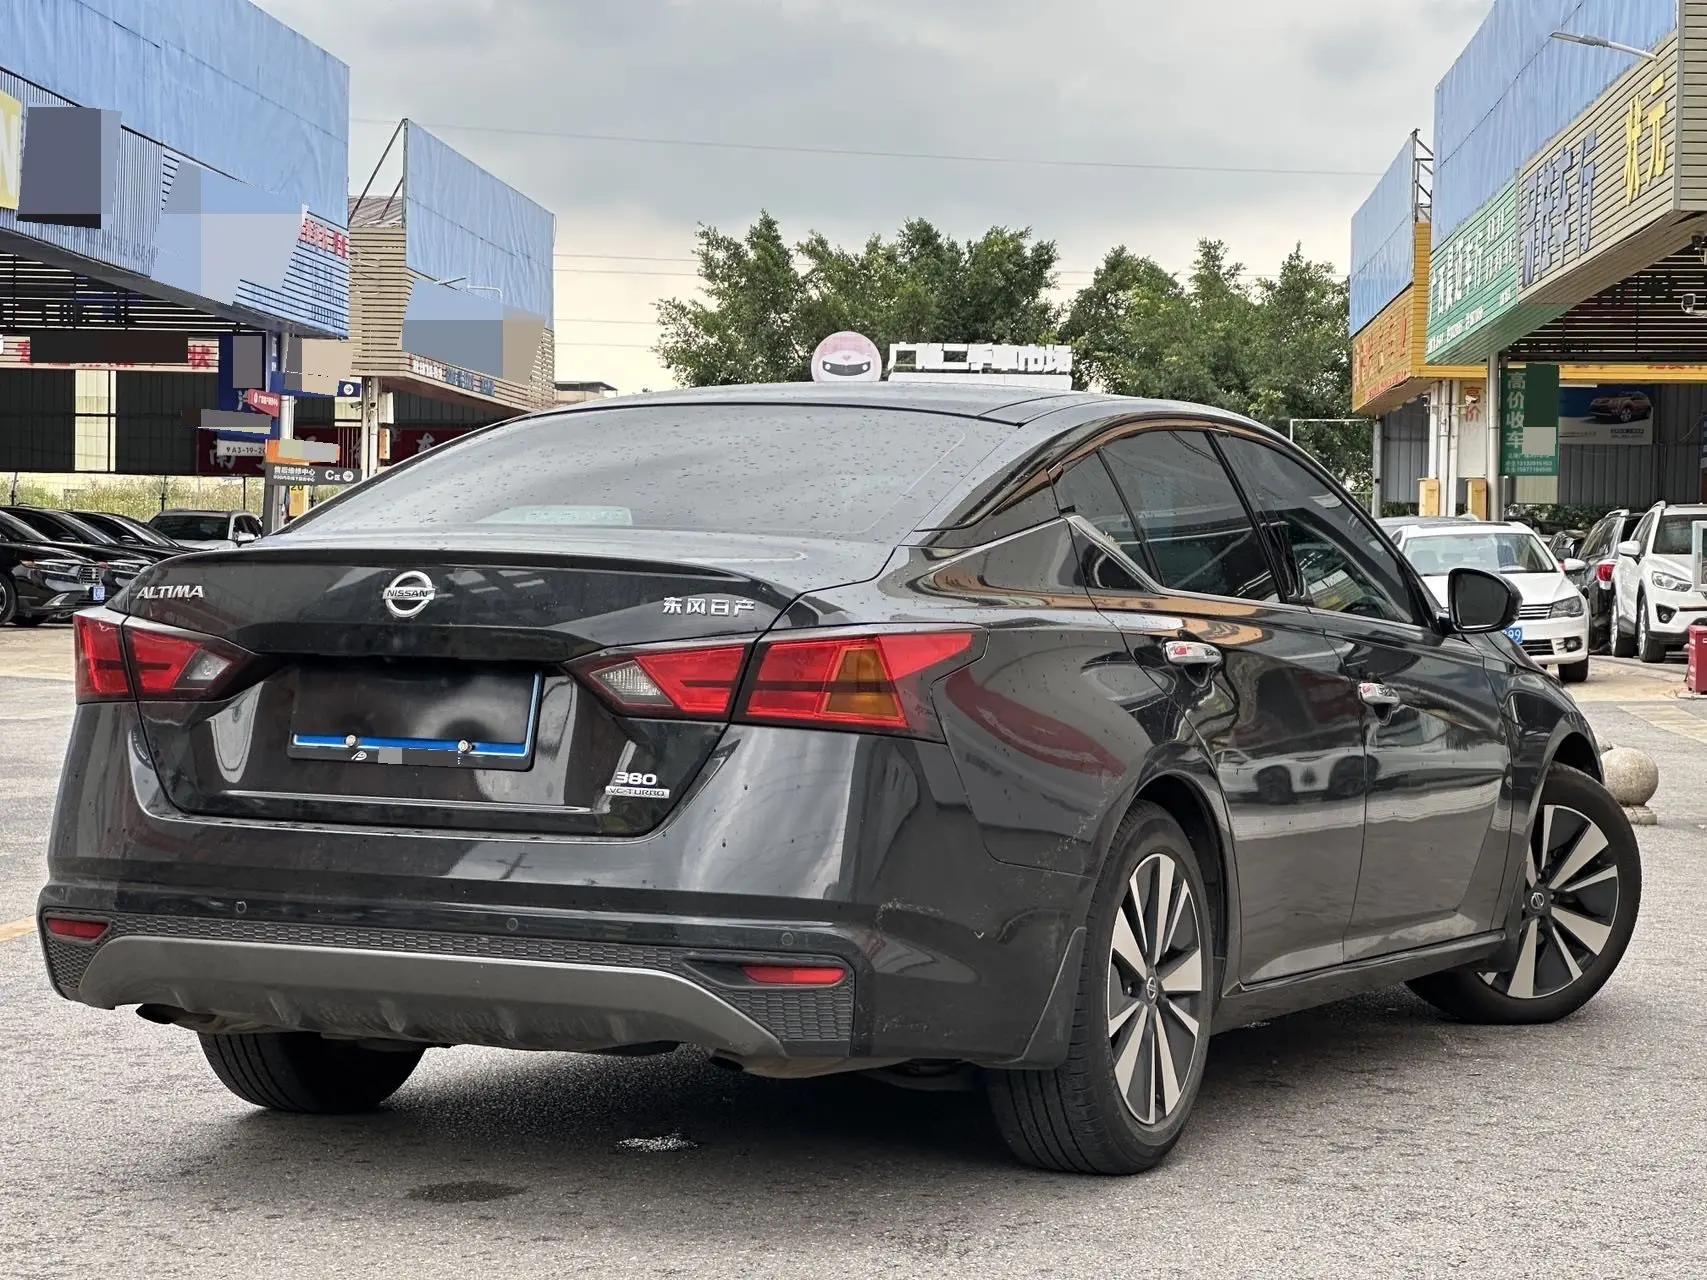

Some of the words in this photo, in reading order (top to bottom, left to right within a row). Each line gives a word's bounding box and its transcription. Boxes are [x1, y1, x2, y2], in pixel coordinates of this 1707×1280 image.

[1623, 72, 1668, 206] 状元
[1505, 372, 1527, 449] 高价收车
[136, 585, 205, 600] ALTIMA
[386, 589, 429, 597] NISSAN
[662, 597, 755, 617] 东风日产
[614, 771, 657, 785] 380
